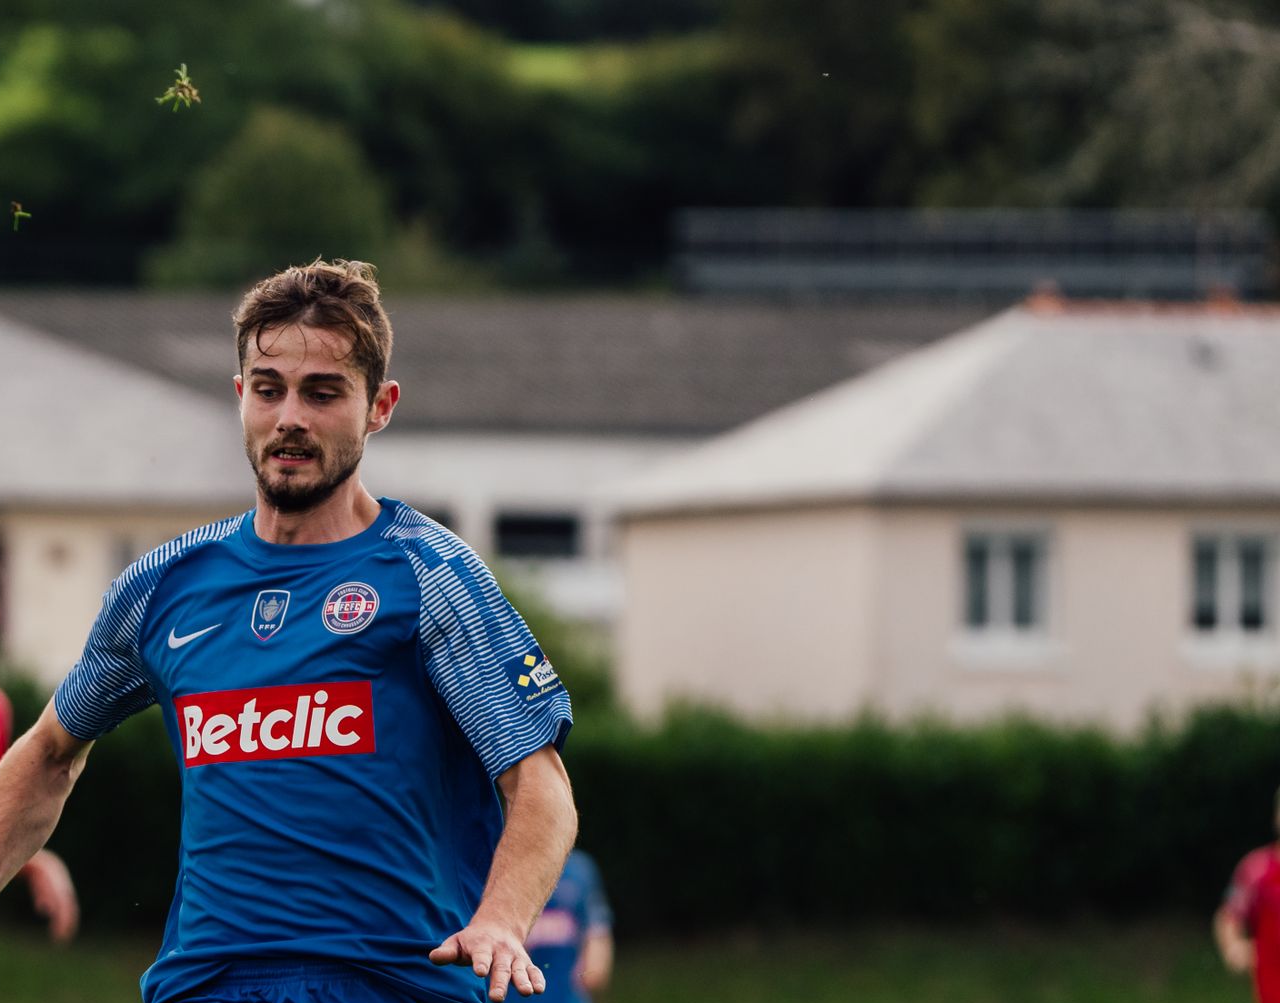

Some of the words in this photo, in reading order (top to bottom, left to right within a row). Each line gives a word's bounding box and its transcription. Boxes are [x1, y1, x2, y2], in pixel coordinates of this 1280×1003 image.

[339, 602, 361, 612] FCFC
[258, 623, 277, 631] FFF
[183, 689, 364, 760] Betclic
